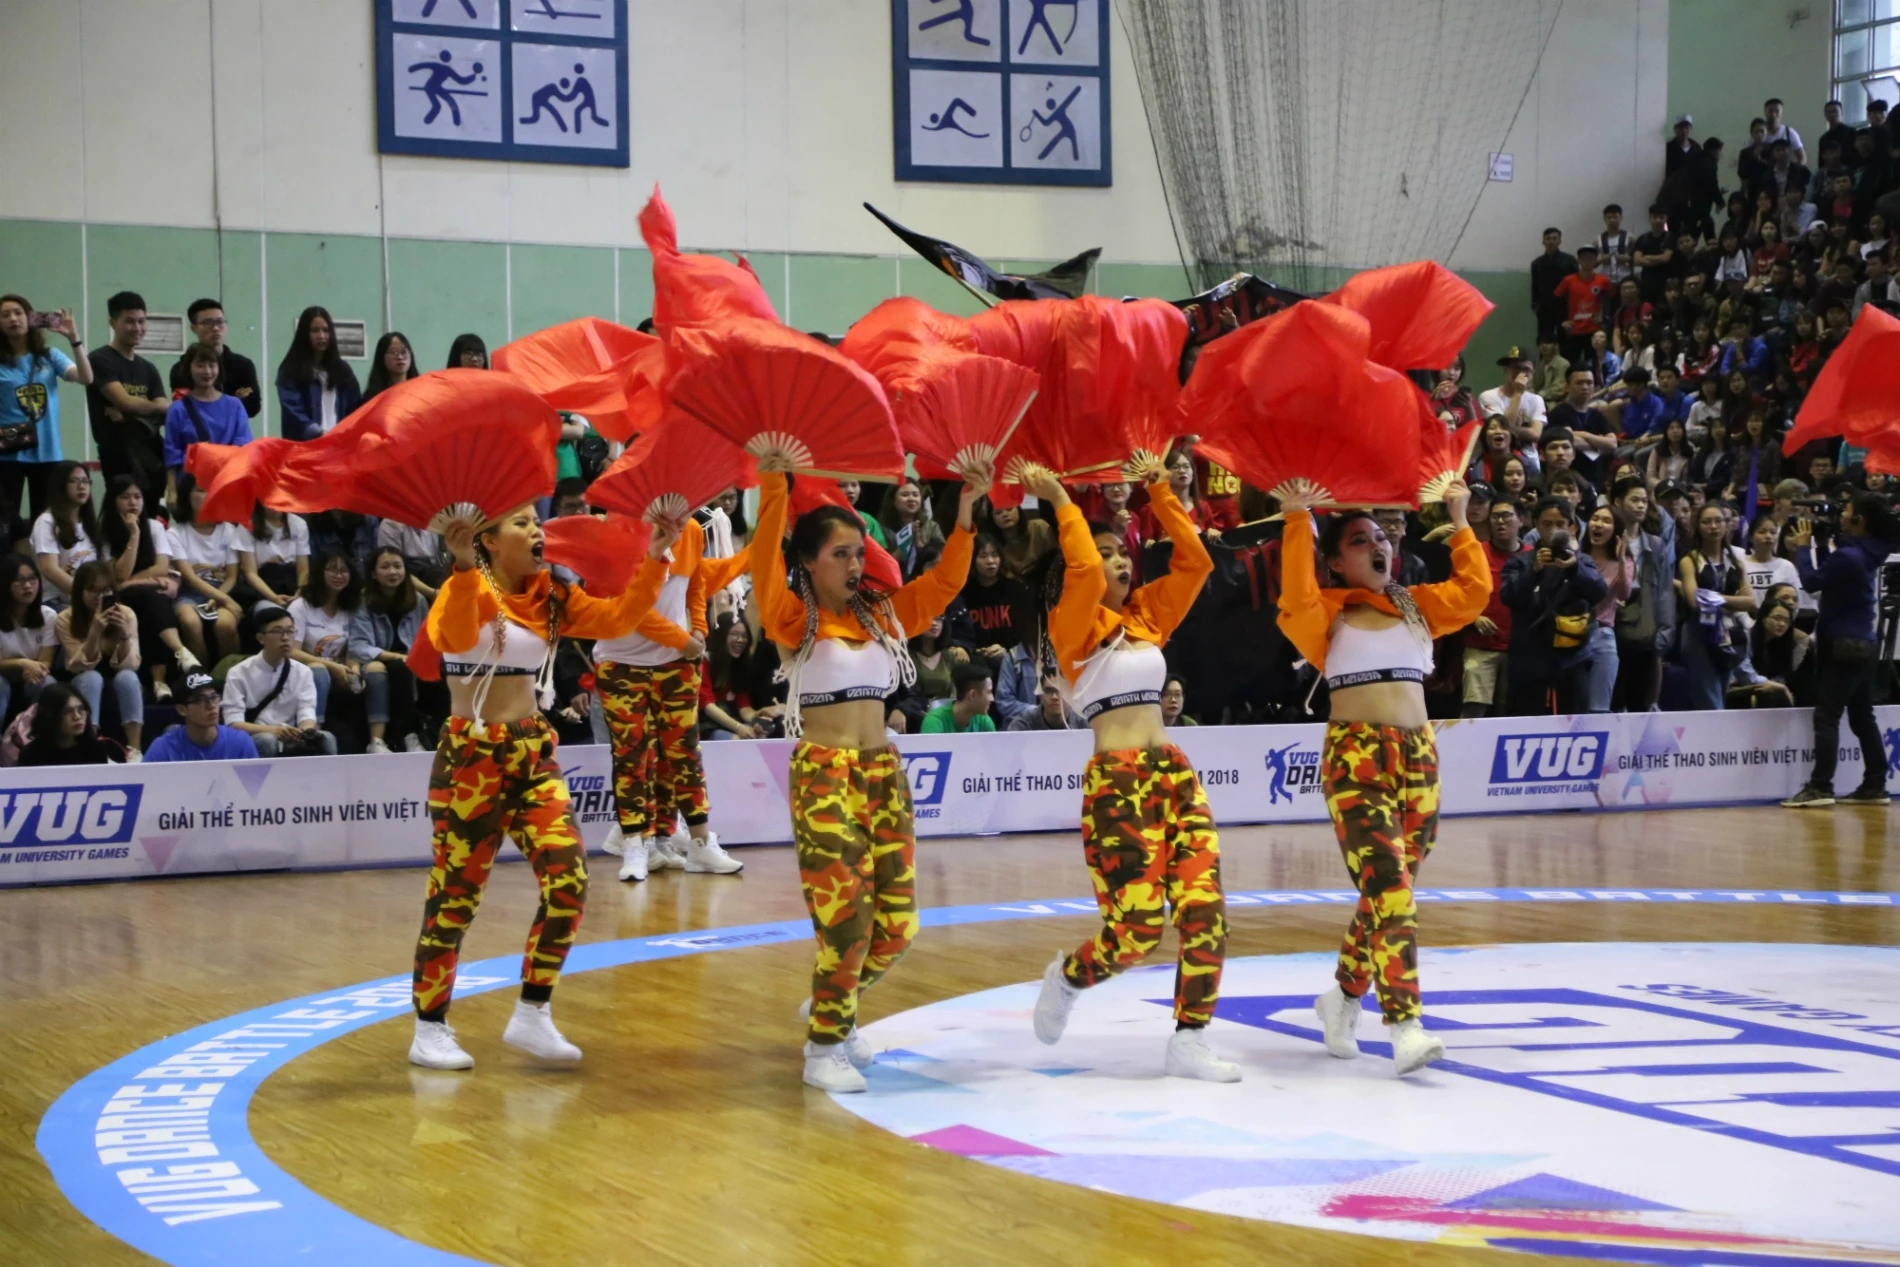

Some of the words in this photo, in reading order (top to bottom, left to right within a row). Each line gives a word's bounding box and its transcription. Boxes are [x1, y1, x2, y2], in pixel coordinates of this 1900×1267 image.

[969, 605, 1012, 630] PUNK
[1289, 751, 1319, 765] VUG
[1503, 736, 1599, 779] VUG
[1673, 752, 1705, 768] THAO
[1708, 750, 1737, 767] SINH
[1741, 747, 1769, 765] VIÊN
[1839, 747, 1861, 762] 018
[568, 776, 605, 791] VUG
[963, 773, 991, 794] GIẢI
[995, 769, 1023, 792] THỂ
[1026, 774, 1063, 791] THAO
[1207, 769, 1239, 785] 2018
[1487, 786, 1523, 797] VIETNAM
[1524, 784, 1571, 795] UNIVERSITY
[159, 806, 194, 831] GIẢI
[200, 802, 234, 828] THỂ
[239, 807, 286, 826] THAO
[292, 805, 333, 824] SINH
[339, 800, 378, 822] VIÊN
[382, 798, 420, 823] VIỆT
[914, 808, 941, 819] AMES
[15, 849, 86, 864] UNIVERSITY
[88, 847, 130, 860] GAMES
[1520, 890, 1893, 905] BATTLE
[132, 1007, 379, 1080] BATTLE
[95, 1082, 226, 1166] DANCE
[116, 1161, 283, 1227] VUG
